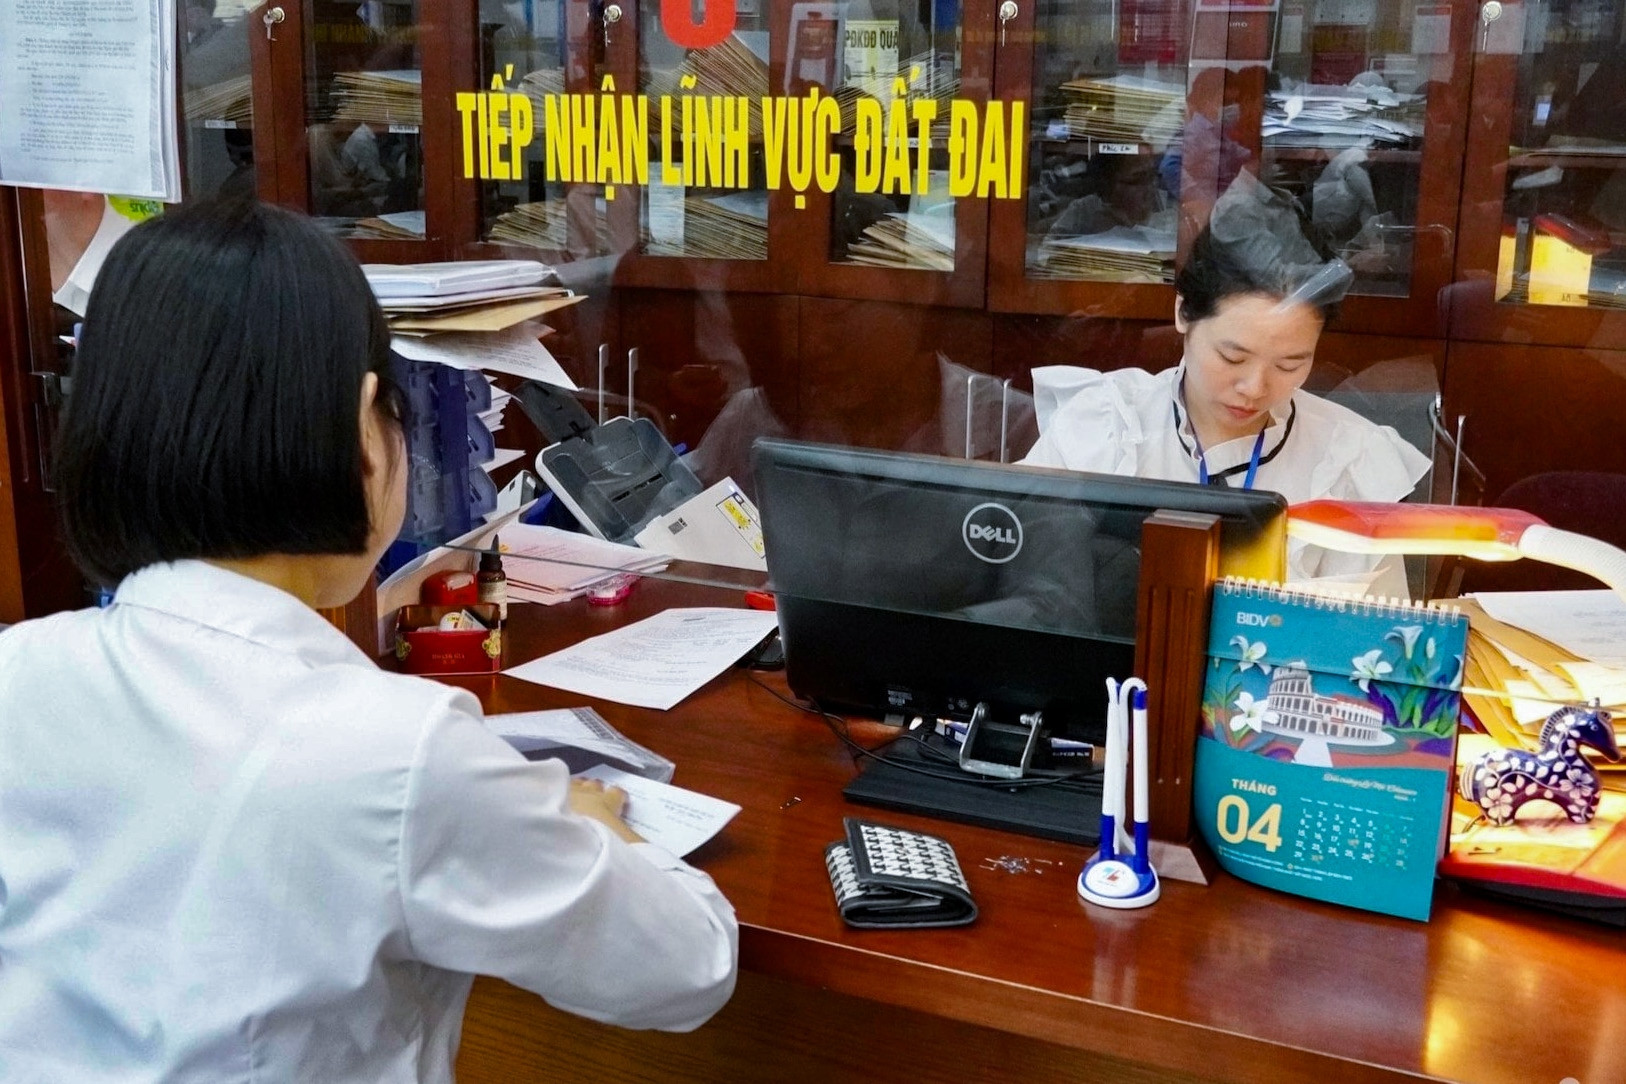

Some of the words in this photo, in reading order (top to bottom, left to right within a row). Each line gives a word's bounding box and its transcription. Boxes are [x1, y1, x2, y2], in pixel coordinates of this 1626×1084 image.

[456, 64, 534, 180] TIẾP
[545, 74, 649, 200] NHẬN
[661, 74, 749, 189] LĨNH
[762, 87, 841, 209] VỰC
[854, 66, 937, 195] ĐẤT
[948, 100, 1024, 199] ĐAI
[969, 523, 1017, 544] DELL
[1236, 611, 1271, 628] BIDV
[1231, 778, 1277, 796] THÁNG
[1217, 794, 1282, 852] 04
